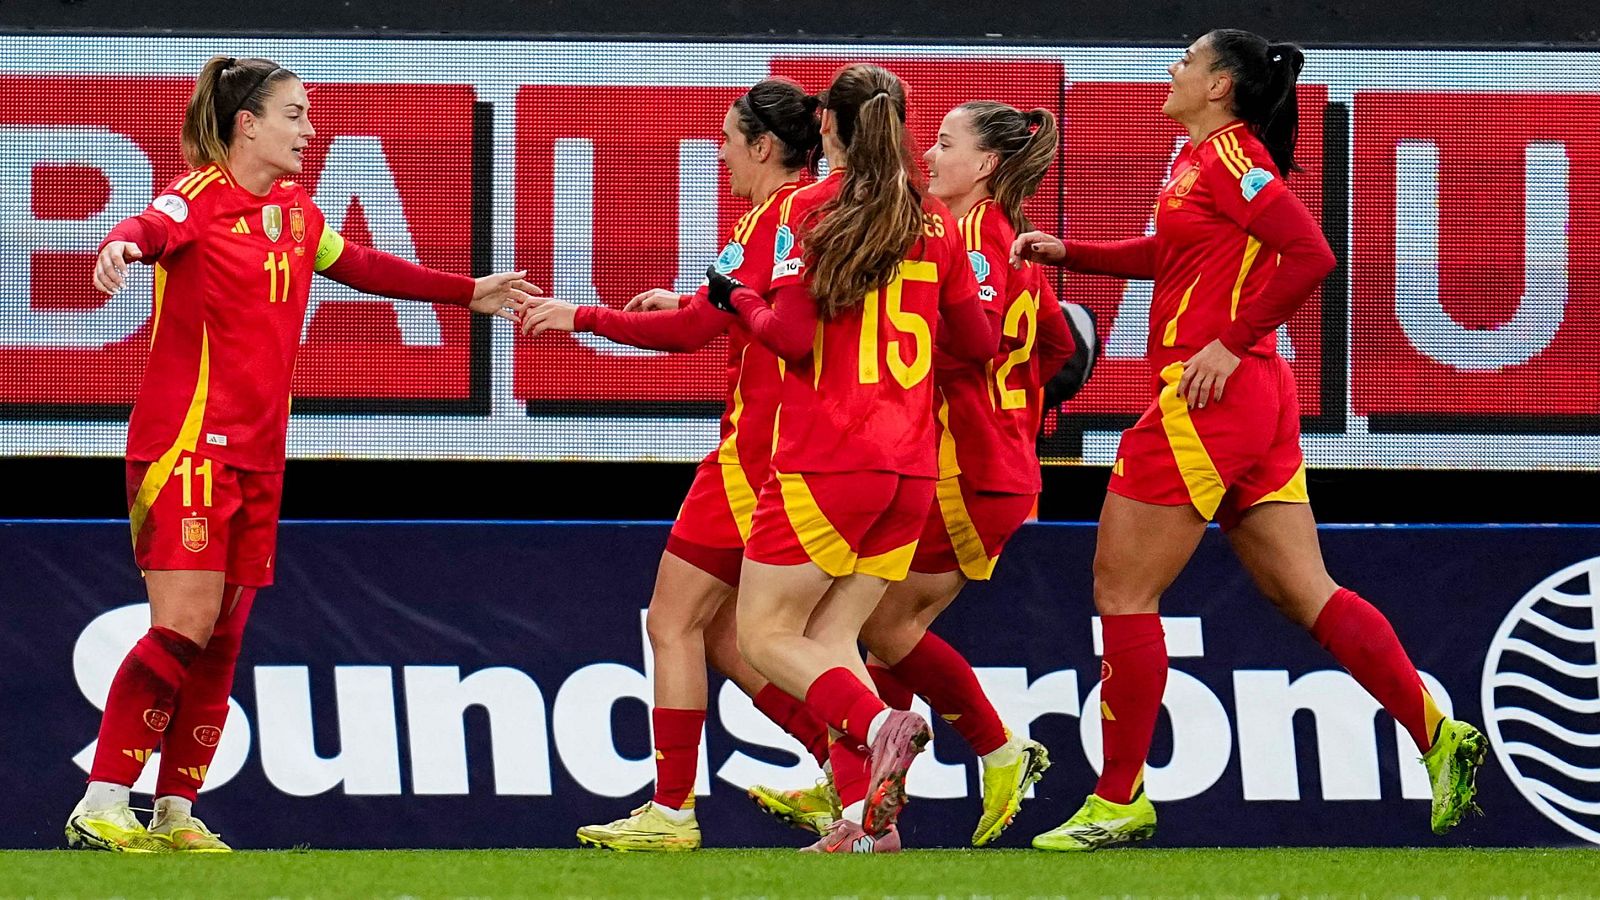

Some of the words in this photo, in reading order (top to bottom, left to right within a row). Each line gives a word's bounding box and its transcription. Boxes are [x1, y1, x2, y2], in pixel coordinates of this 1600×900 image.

[264, 252, 290, 303] 11
[858, 260, 938, 390] 15
[996, 287, 1040, 410] 2
[174, 457, 213, 507] 11
